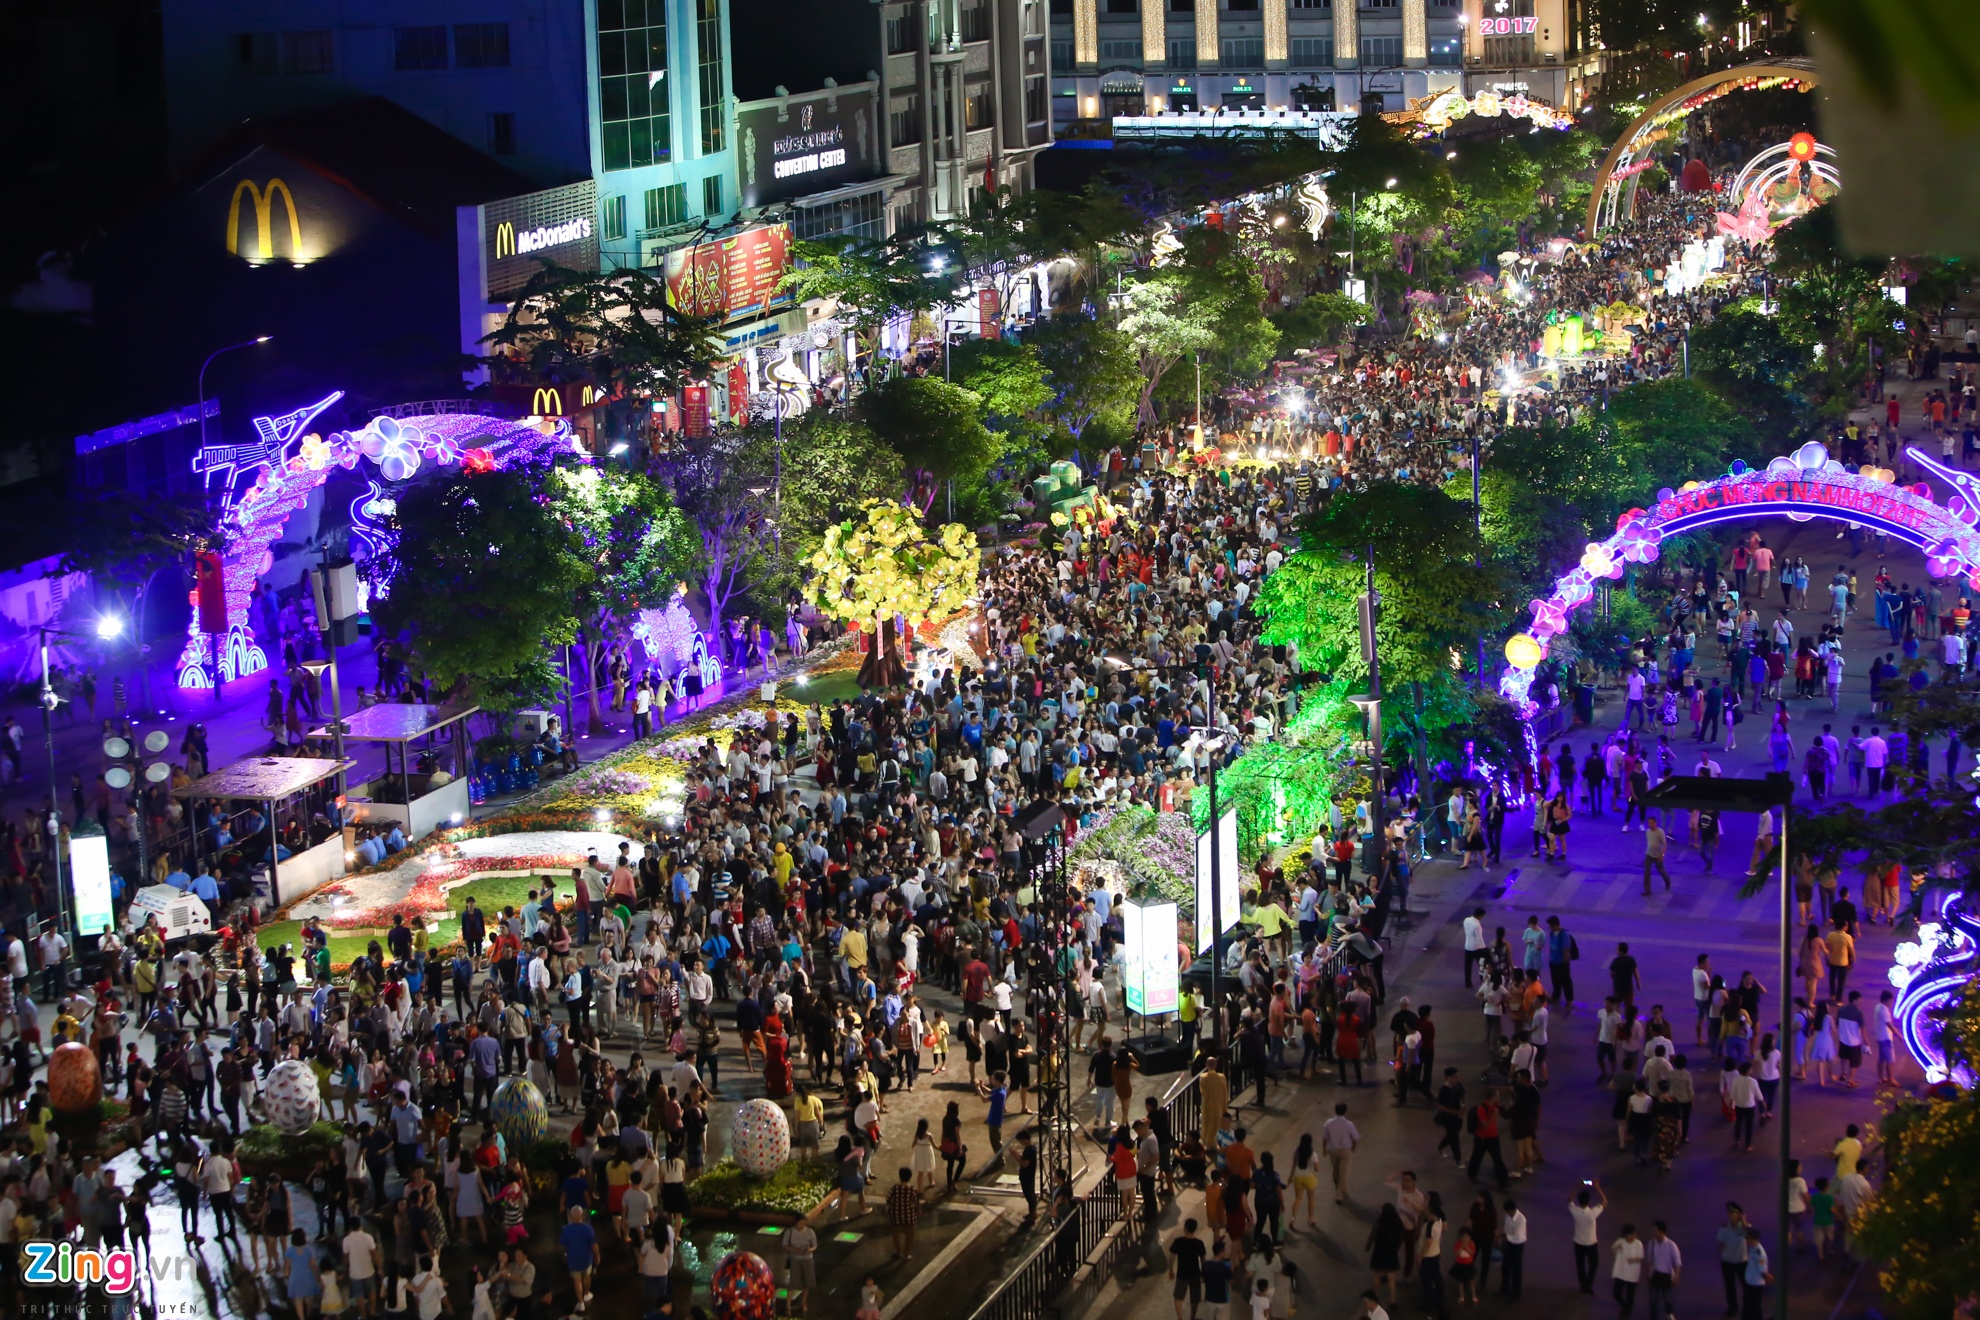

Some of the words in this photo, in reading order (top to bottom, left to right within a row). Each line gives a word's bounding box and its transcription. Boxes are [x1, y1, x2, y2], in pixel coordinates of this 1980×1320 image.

[1479, 16, 1539, 36] 2017
[774, 153, 819, 179] CONVENTION
[819, 148, 846, 169] CENTER
[518, 217, 591, 255] McDonald's
[1883, 499, 1928, 528] 2017
